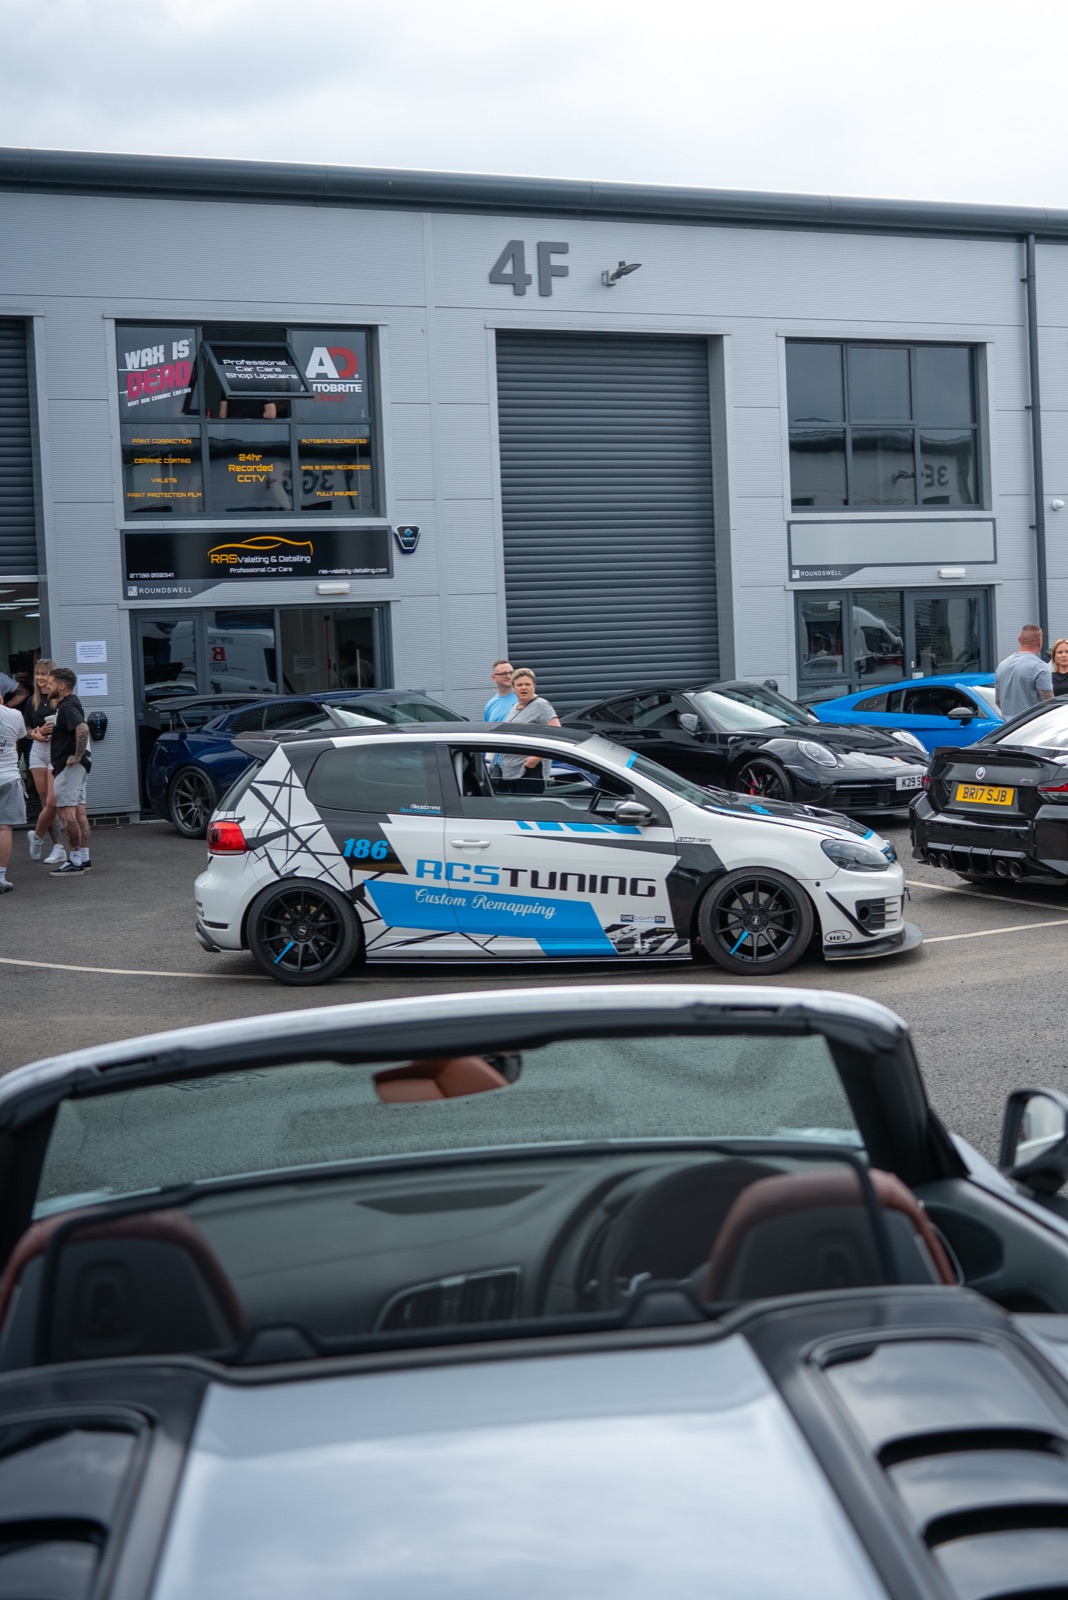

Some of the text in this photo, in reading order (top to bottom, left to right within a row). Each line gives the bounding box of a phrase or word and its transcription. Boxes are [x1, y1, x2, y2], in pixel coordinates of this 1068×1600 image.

[488, 240, 570, 297] 4F
[125, 340, 190, 369] WAX IS
[127, 360, 191, 400] DEAD
[238, 453, 262, 461] 24hr
[228, 464, 274, 472] Recorded
[237, 474, 266, 482] CCTV
[210, 554, 238, 564] RAS
[238, 555, 270, 564] Valeting
[279, 555, 311, 563] Detailing
[902, 777, 916, 788] K29
[962, 788, 1007, 802] BR17 SJB
[343, 838, 388, 860] 186
[415, 889, 557, 919] Custom Remapping
